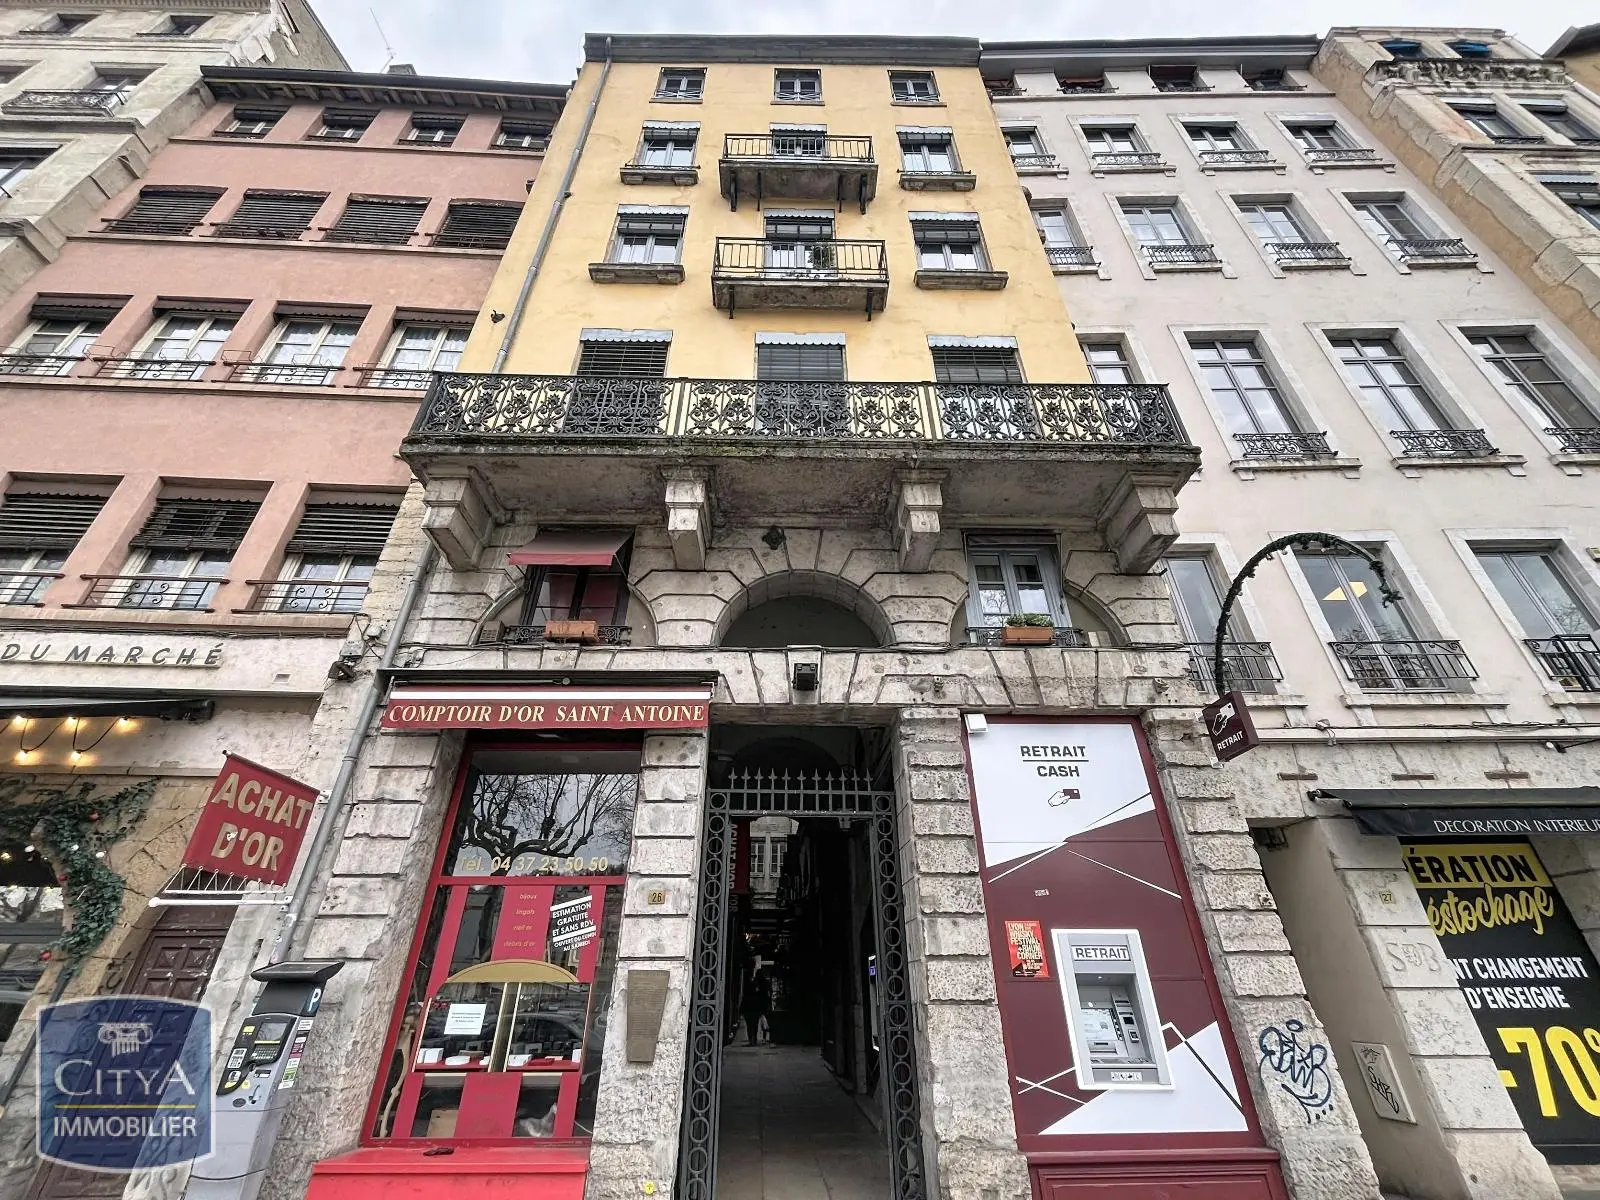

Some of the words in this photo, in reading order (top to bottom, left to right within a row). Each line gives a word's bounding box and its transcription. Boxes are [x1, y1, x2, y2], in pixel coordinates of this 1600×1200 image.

[1, 643, 51, 660] DU
[65, 643, 224, 665] MARCHÉ
[389, 705, 492, 722] COMPTOIR
[498, 705, 545, 722] D'OR
[555, 705, 613, 722] SAINT
[619, 705, 704, 722] ANTOINE
[1217, 730, 1244, 751] RETRAIT
[1020, 745, 1086, 757] RETRAIT
[1036, 765, 1080, 777] CASH
[211, 772, 312, 829] ACHAT
[1434, 820, 1532, 833] DECORATION
[211, 822, 284, 871] D'OR
[491, 856, 511, 872] 04
[515, 856, 536, 871] 37
[539, 856, 559, 871] 23
[565, 857, 584, 872] 50
[588, 856, 609, 872] 50
[1402, 847, 1537, 883] ÉRATION
[652, 892, 662, 902] 26
[1381, 894, 1392, 902] 27
[552, 902, 592, 919] ESTIMATION
[557, 911, 588, 926] GRATUITE
[561, 923, 579, 934] SANS
[580, 919, 594, 929] RDV
[1075, 948, 1128, 959] RETRAIT
[1473, 957, 1589, 979] CHANGEMENT
[309, 988, 322, 1012] P
[1464, 987, 1571, 1009] D'ENSEIGNE
